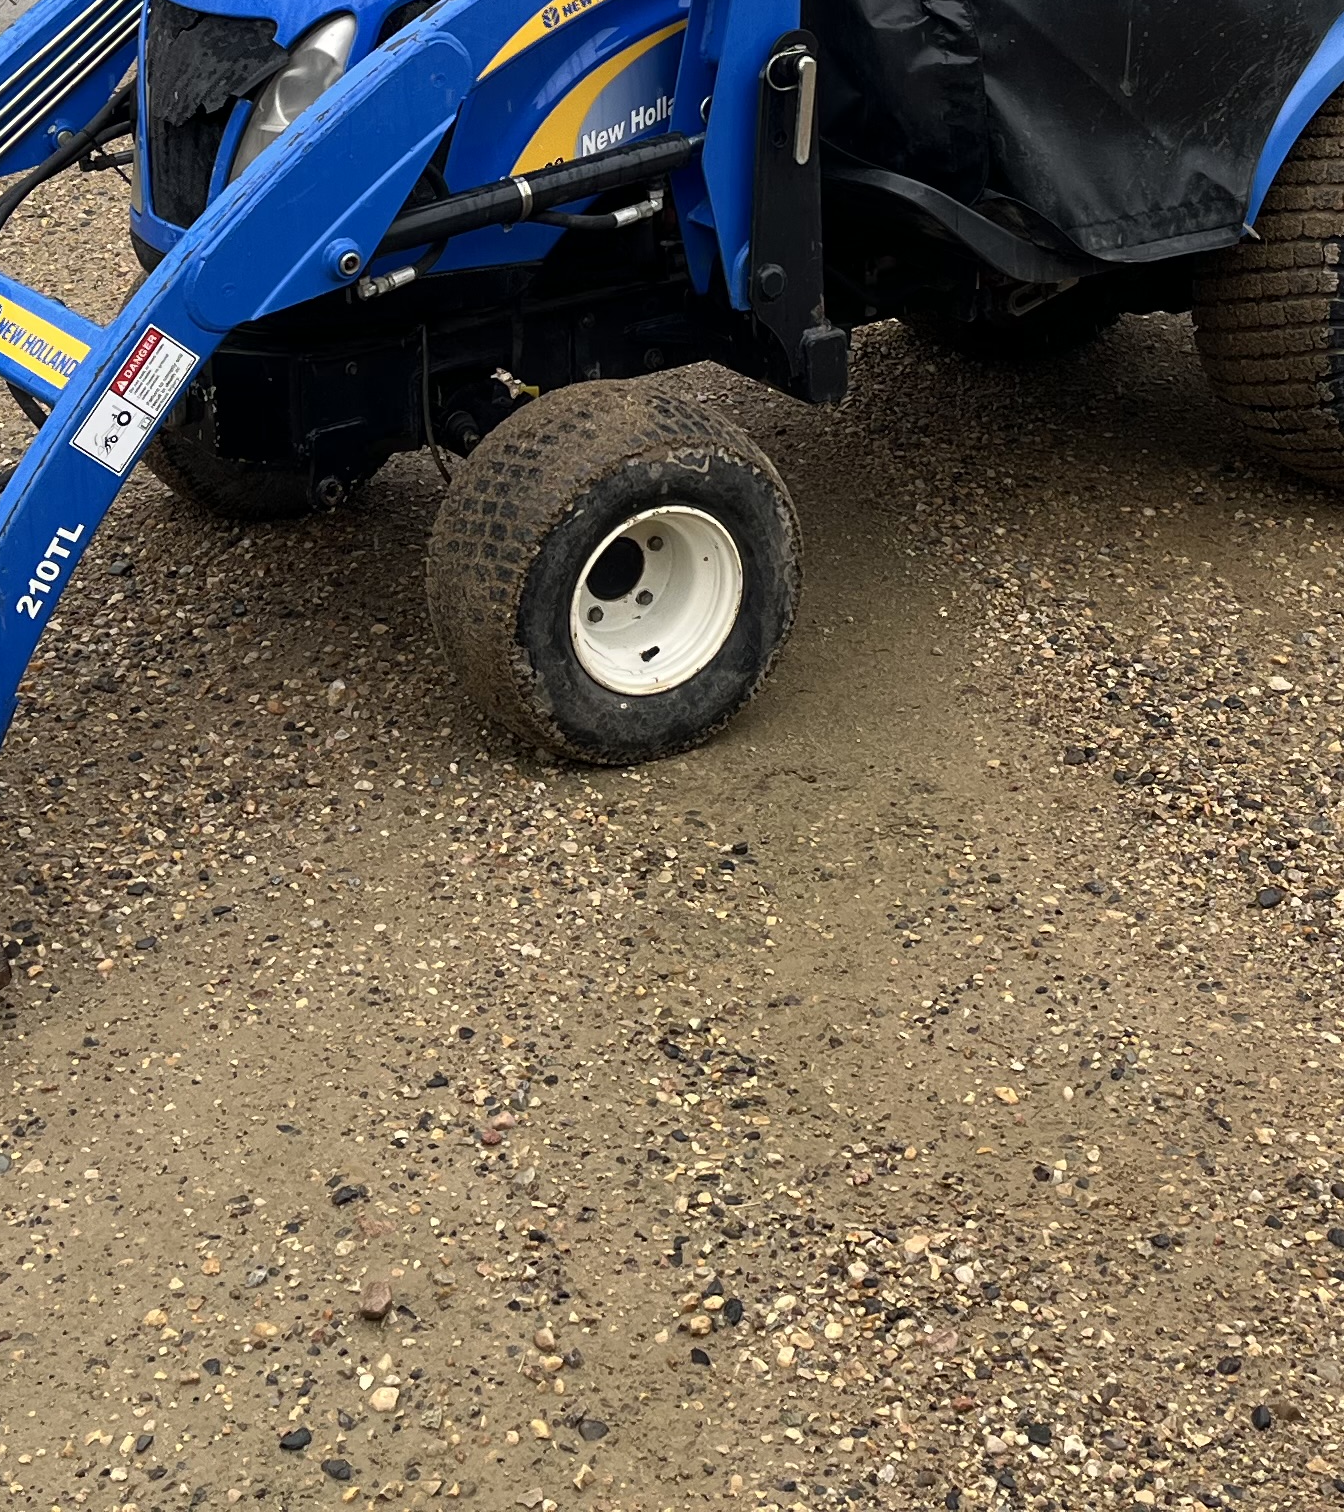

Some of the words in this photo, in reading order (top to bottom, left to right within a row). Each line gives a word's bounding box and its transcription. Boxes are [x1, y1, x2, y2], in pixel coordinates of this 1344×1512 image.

[582, 120, 626, 157] New
[20, 333, 80, 378] HOLLAND
[123, 334, 158, 379] DANGER
[16, 524, 85, 619] 210TL
